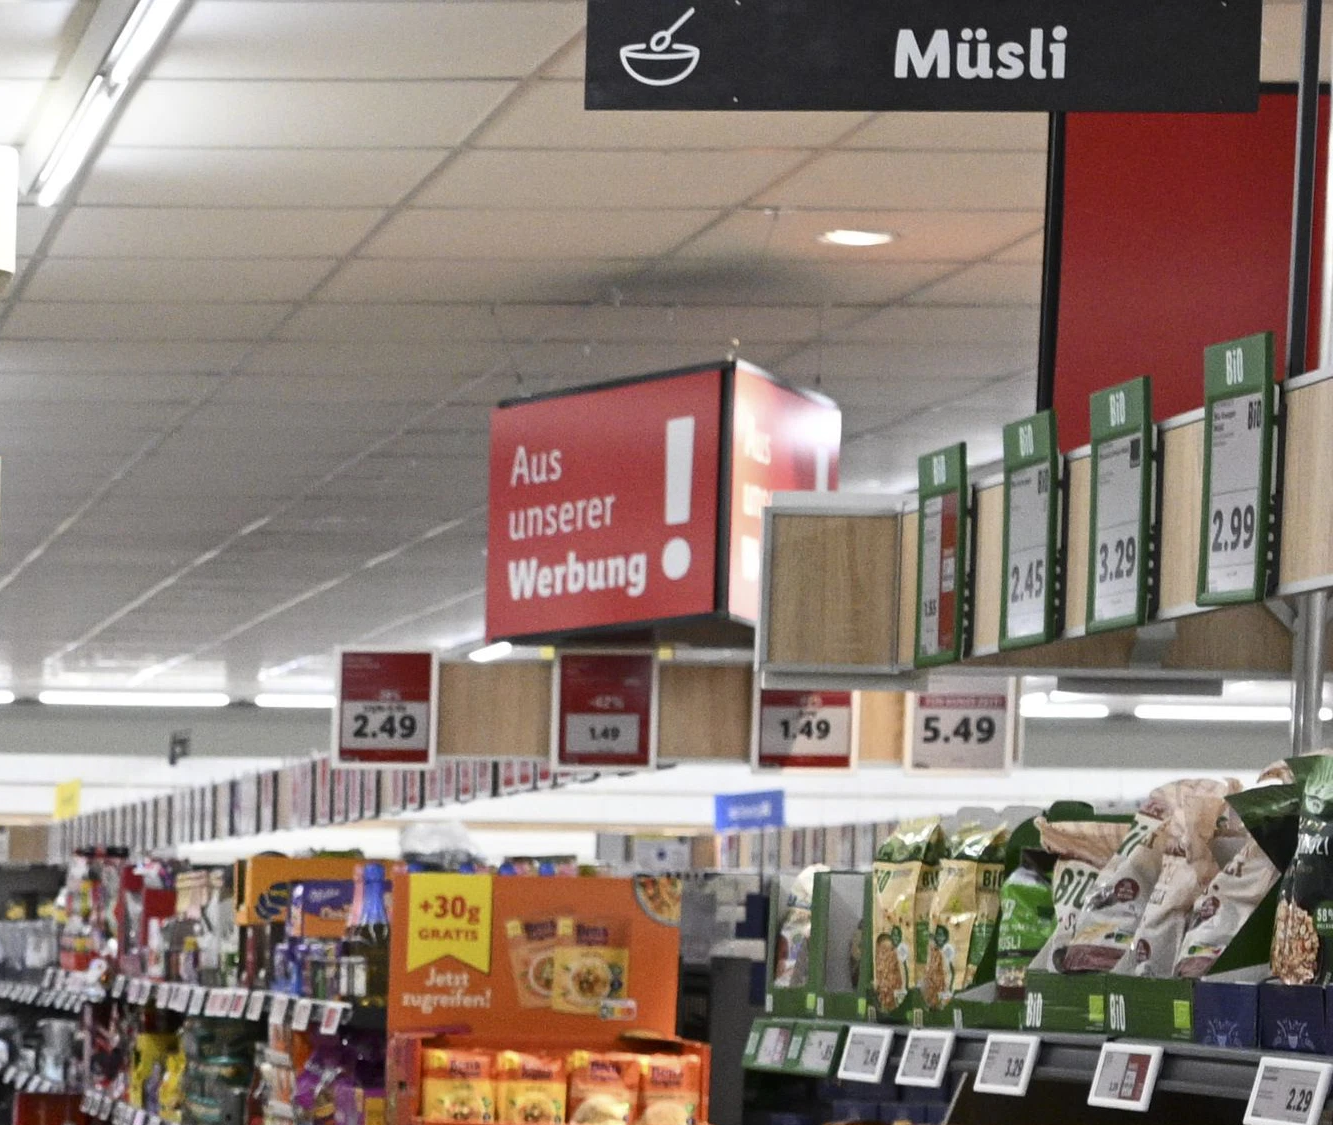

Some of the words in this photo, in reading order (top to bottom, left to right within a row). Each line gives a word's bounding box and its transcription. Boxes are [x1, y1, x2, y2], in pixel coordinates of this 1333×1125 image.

[894, 26, 1068, 80] Müsli
[510, 446, 562, 487] Aus
[509, 494, 617, 541] unserer
[1212, 505, 1254, 552] 2.99
[1100, 537, 1136, 584] 3.29
[508, 551, 646, 600] Werbung
[1012, 560, 1044, 602] 2.45
[353, 715, 416, 739] 2.49
[589, 727, 620, 741] 1.49
[780, 720, 831, 741] 1.49
[923, 716, 996, 744] 5.49
[419, 894, 481, 924] +30g
[418, 926, 479, 942] GRATIS
[425, 967, 470, 989] Jetzt
[402, 989, 492, 1014] zugreifen!
[1286, 1087, 1313, 1112] 2.29
